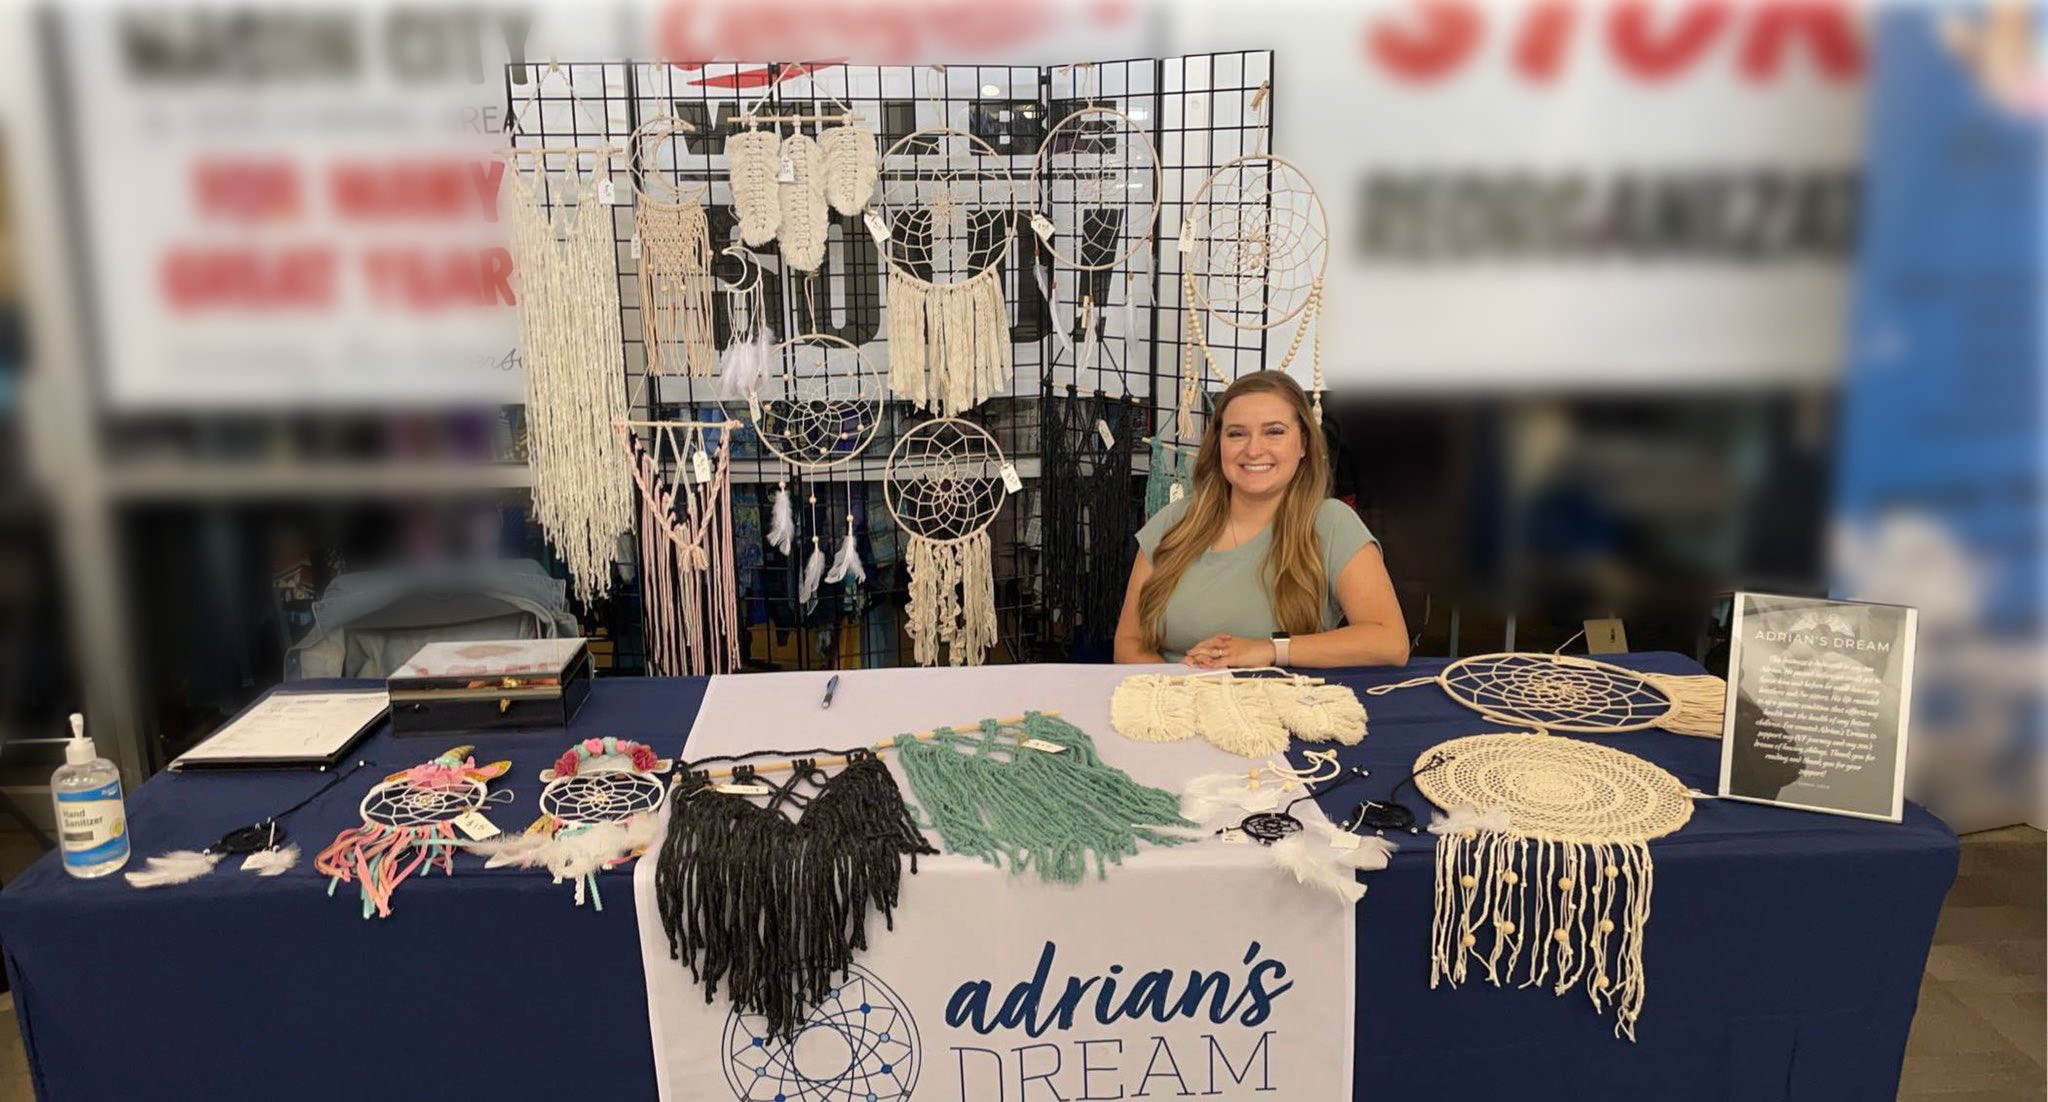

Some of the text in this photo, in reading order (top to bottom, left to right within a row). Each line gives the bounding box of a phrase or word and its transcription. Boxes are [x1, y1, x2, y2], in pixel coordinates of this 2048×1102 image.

[1755, 630, 1890, 652] ADRIAN'S DREAM
[63, 808, 86, 819] Hand
[64, 815, 103, 828] Sanitizer
[945, 941, 1294, 1038] adrian's
[950, 1031, 1278, 1102] DREAM
